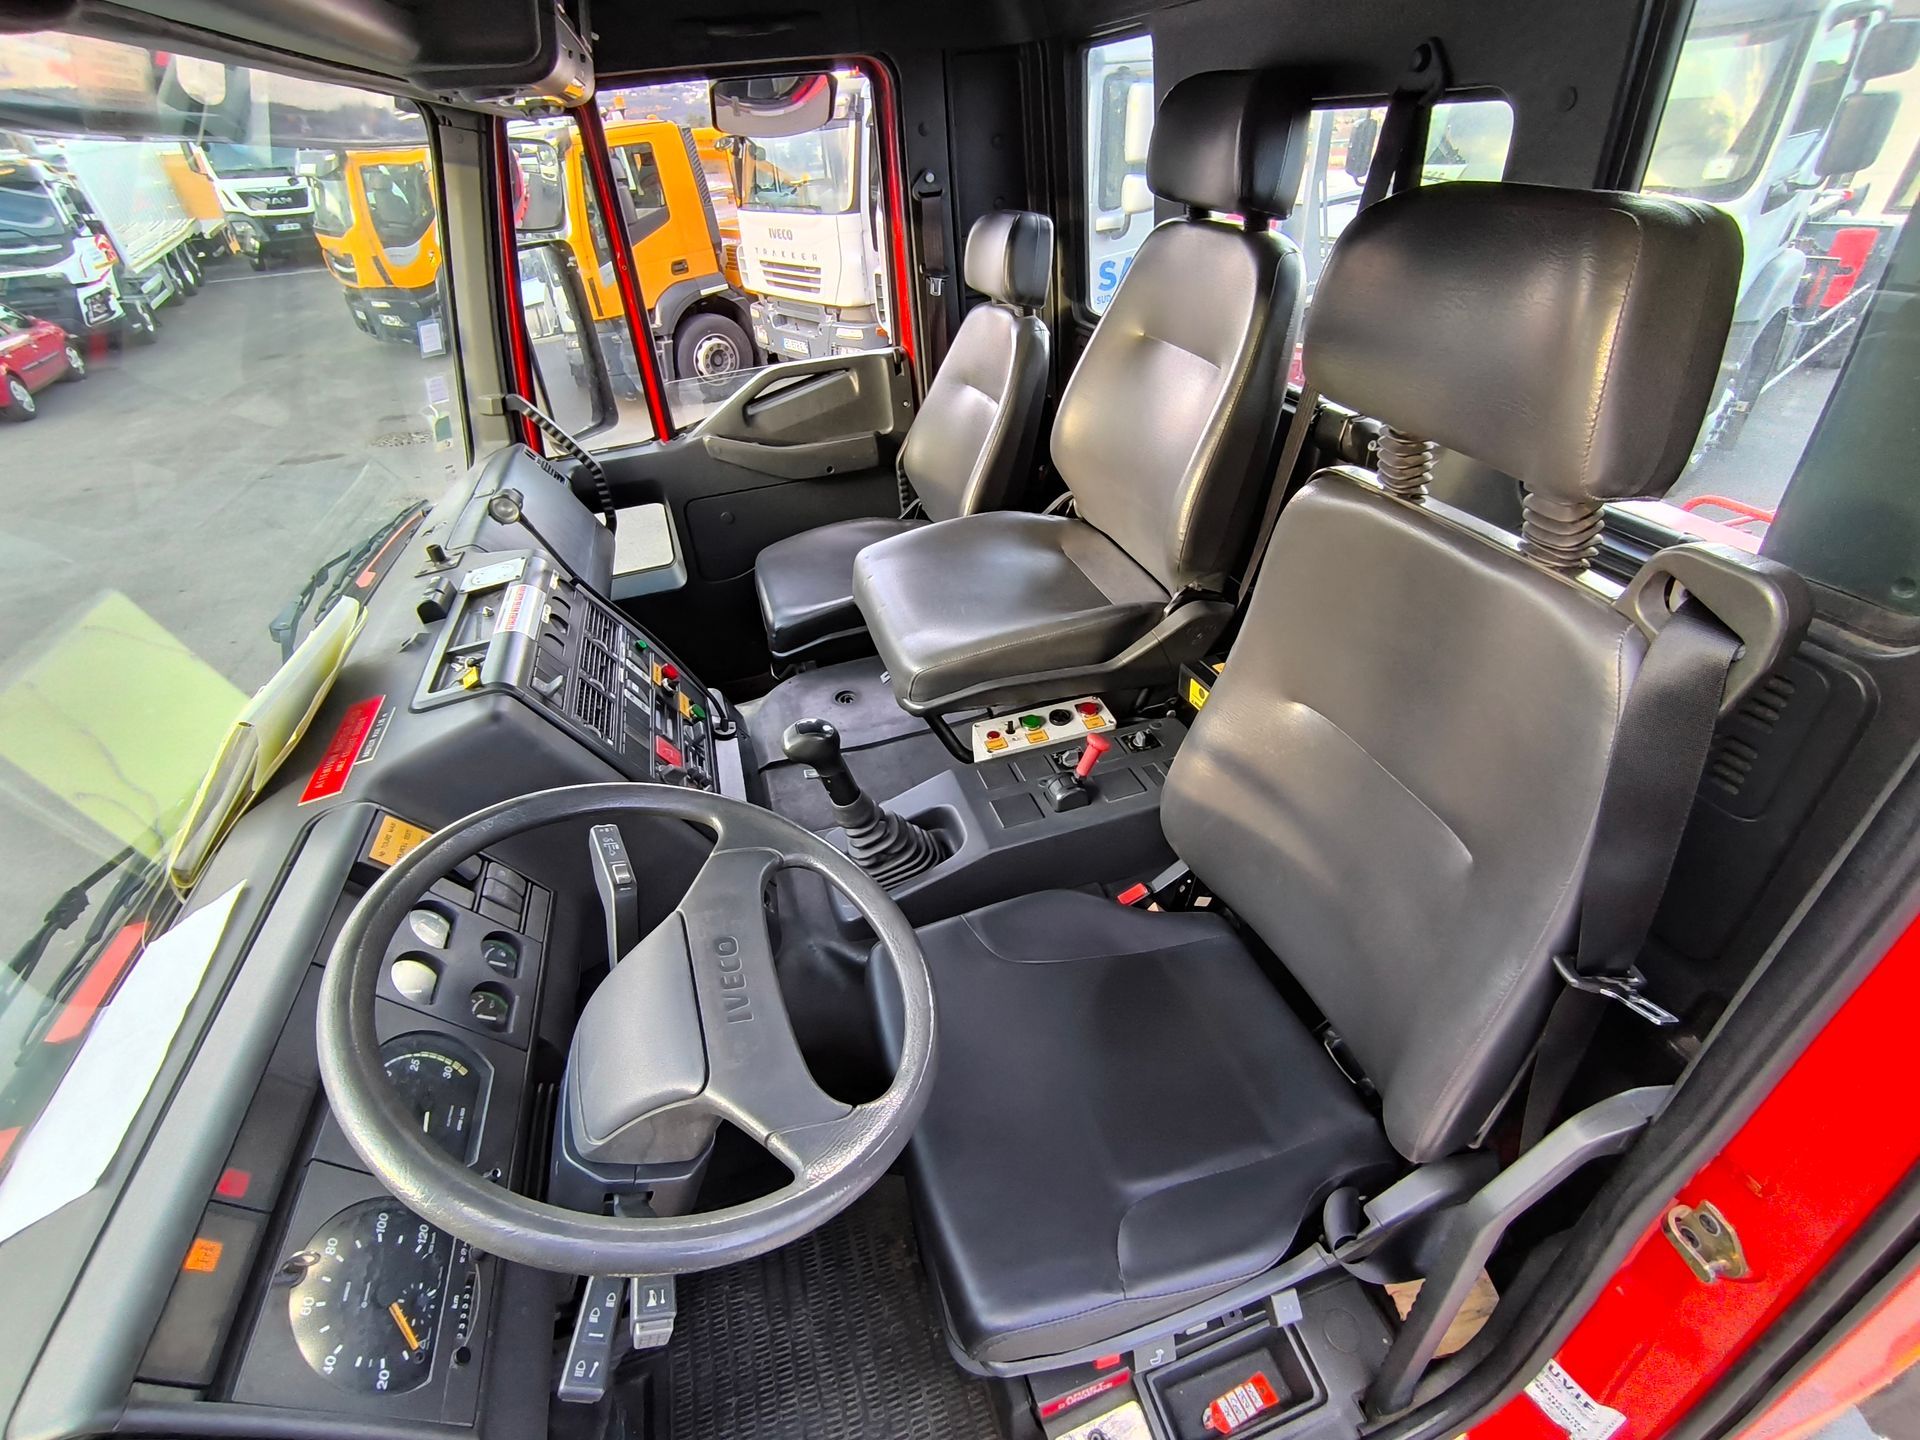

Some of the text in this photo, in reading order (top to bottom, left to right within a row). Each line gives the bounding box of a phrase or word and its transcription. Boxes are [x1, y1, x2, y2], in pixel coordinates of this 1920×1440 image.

[768, 228, 793, 241] IVECO
[715, 936, 755, 1025] IVECO
[410, 1058, 421, 1072] 25
[442, 1065, 454, 1080] 30
[376, 1212, 389, 1234] 100
[418, 1224, 430, 1246] 120
[325, 1237, 339, 1256] 80
[301, 1296, 316, 1317] 60
[322, 1354, 338, 1376] 40
[376, 1369, 390, 1391] 20
